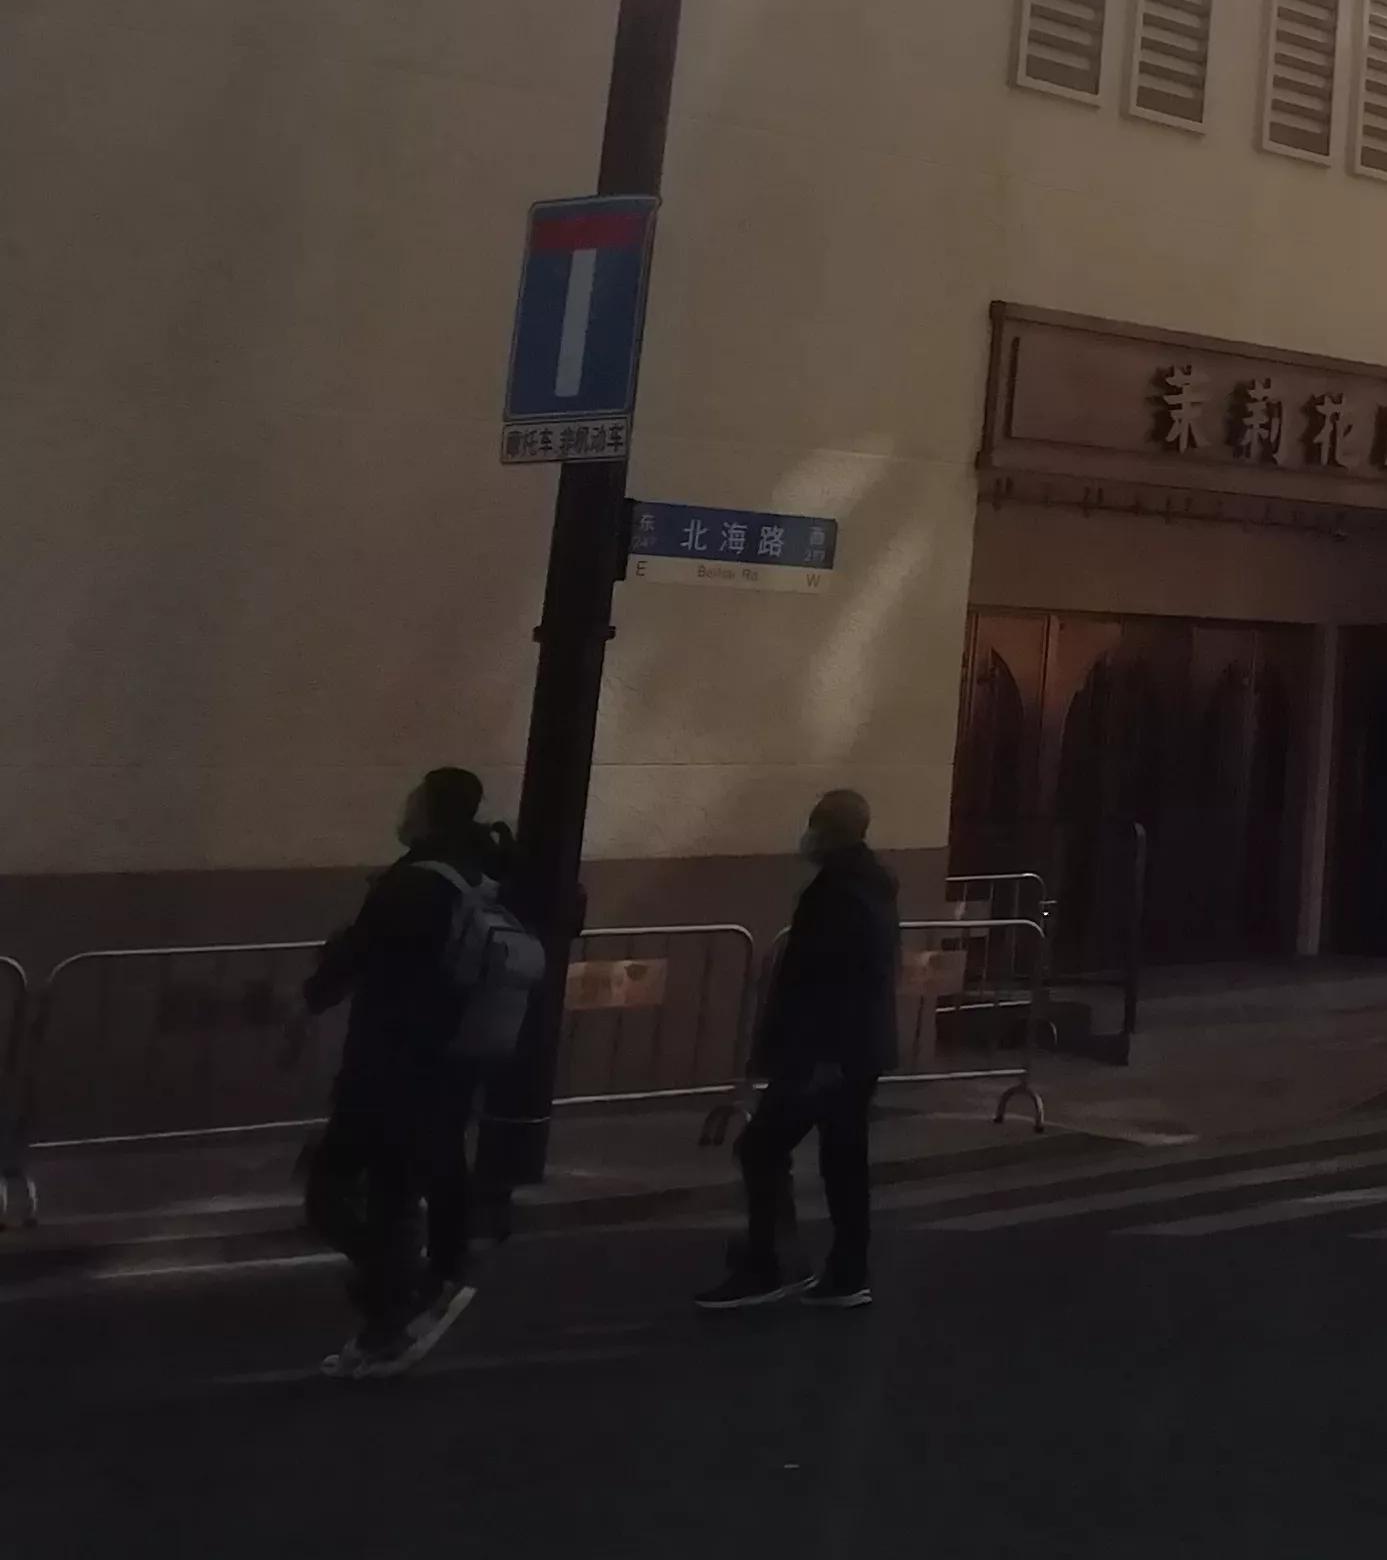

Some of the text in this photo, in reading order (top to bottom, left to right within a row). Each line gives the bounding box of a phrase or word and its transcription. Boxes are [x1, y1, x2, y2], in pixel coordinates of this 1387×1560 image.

[680, 519, 785, 557] 北海路
[636, 560, 649, 576] E
[806, 573, 821, 588] W
